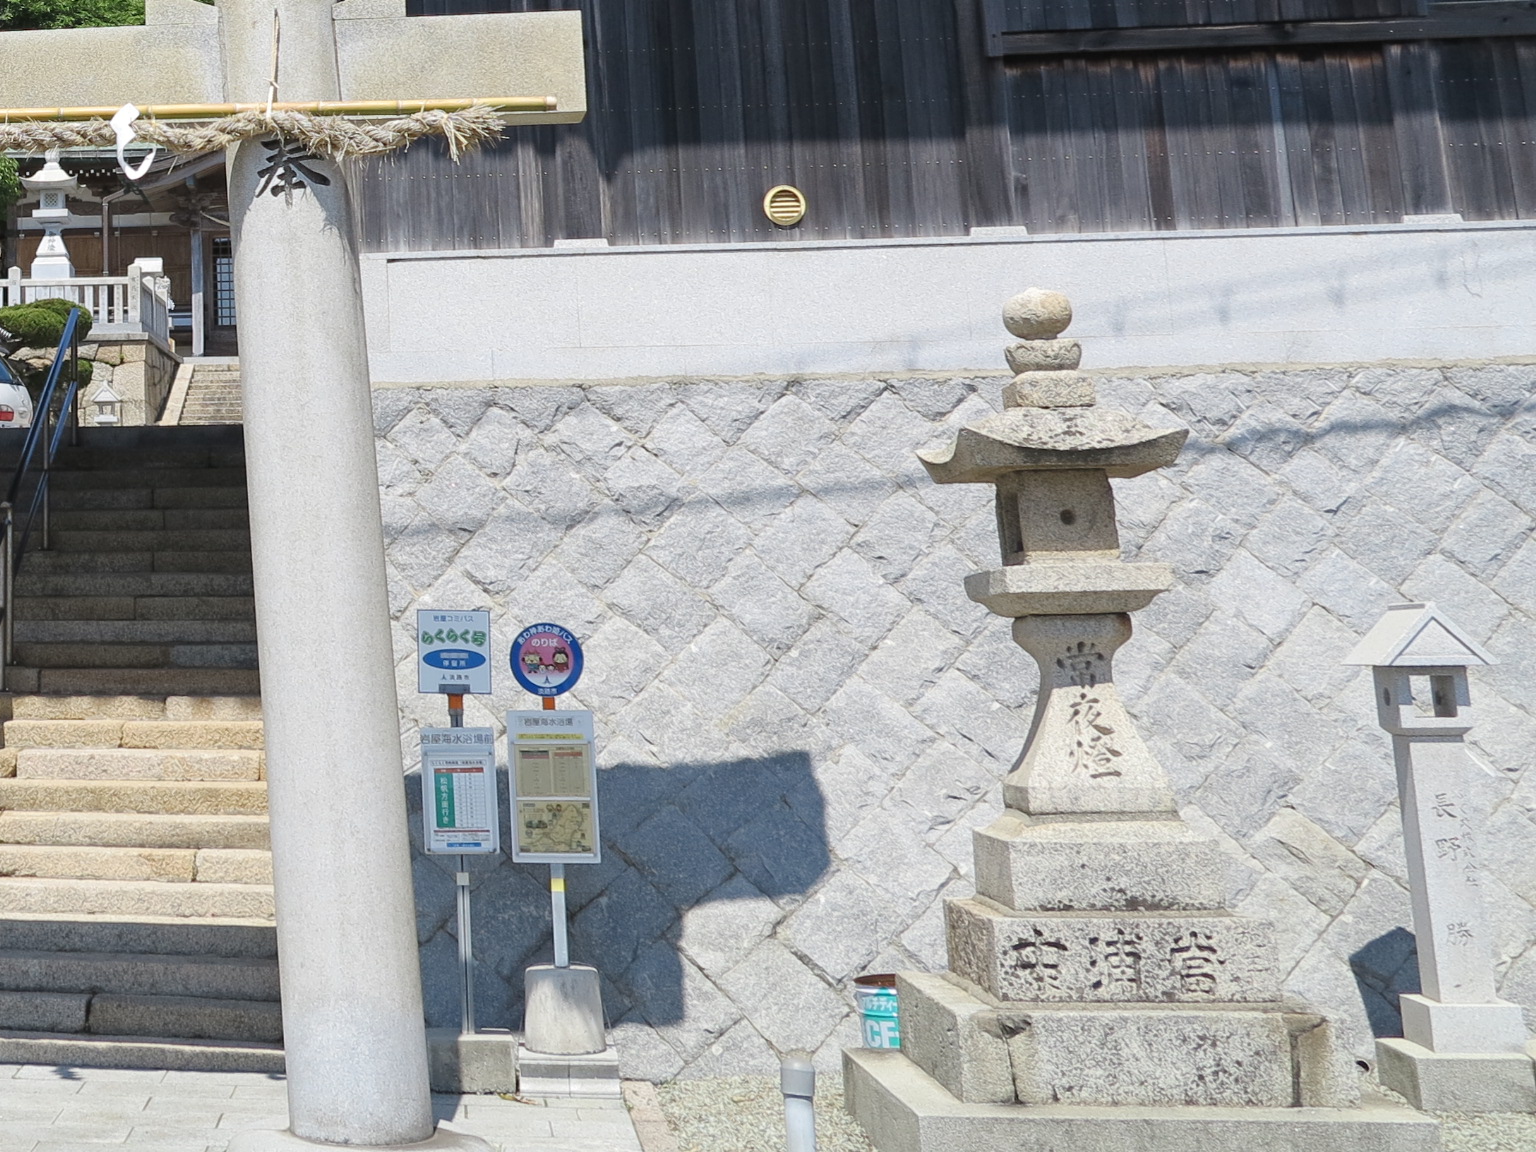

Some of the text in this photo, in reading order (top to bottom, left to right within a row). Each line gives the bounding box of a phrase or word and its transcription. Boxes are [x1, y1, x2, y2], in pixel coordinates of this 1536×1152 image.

[256, 133, 331, 203] 奉
[421, 628, 487, 648] らくらく号
[531, 638, 559, 647] のりば
[1056, 641, 1123, 779] 常夜燈
[524, 717, 574, 726] 岩屋海水浴場
[421, 733, 494, 745] 岩屋海水浴場前
